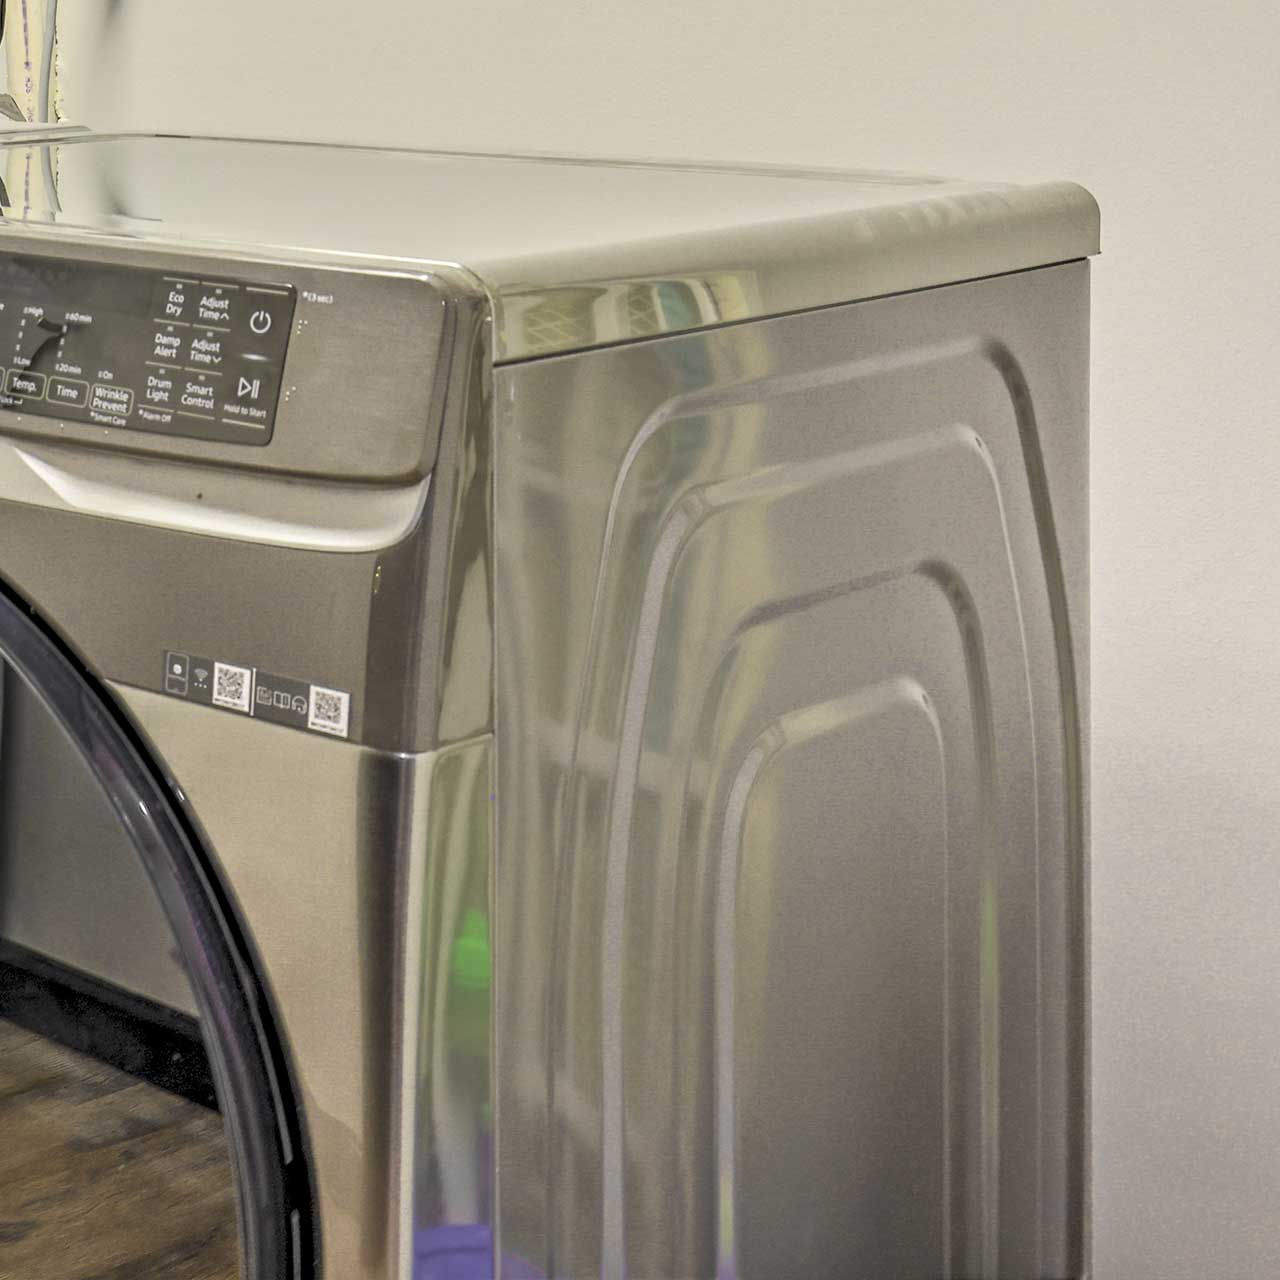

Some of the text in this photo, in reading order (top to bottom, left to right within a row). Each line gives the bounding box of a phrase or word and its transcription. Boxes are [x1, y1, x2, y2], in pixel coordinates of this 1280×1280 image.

[168, 291, 185, 303] Eco
[200, 296, 230, 310] Adjust
[28, 306, 44, 317] High
[166, 304, 183, 316] Dry
[198, 308, 220, 320] Time
[155, 333, 180, 348] Damp
[191, 339, 221, 353] Adjust
[154, 345, 177, 358] Alert
[190, 351, 212, 363] Time
[18, 357, 31, 366] Low
[13, 377, 37, 393] Temp.
[147, 376, 172, 389] Drum
[186, 382, 214, 396] Smart
[56, 384, 79, 399] Time
[95, 387, 129, 403] Wrinkle
[146, 388, 169, 402] Light
[92, 399, 128, 413] Prevent
[181, 394, 215, 409] Control
[224, 404, 267, 418] Hold to Start
